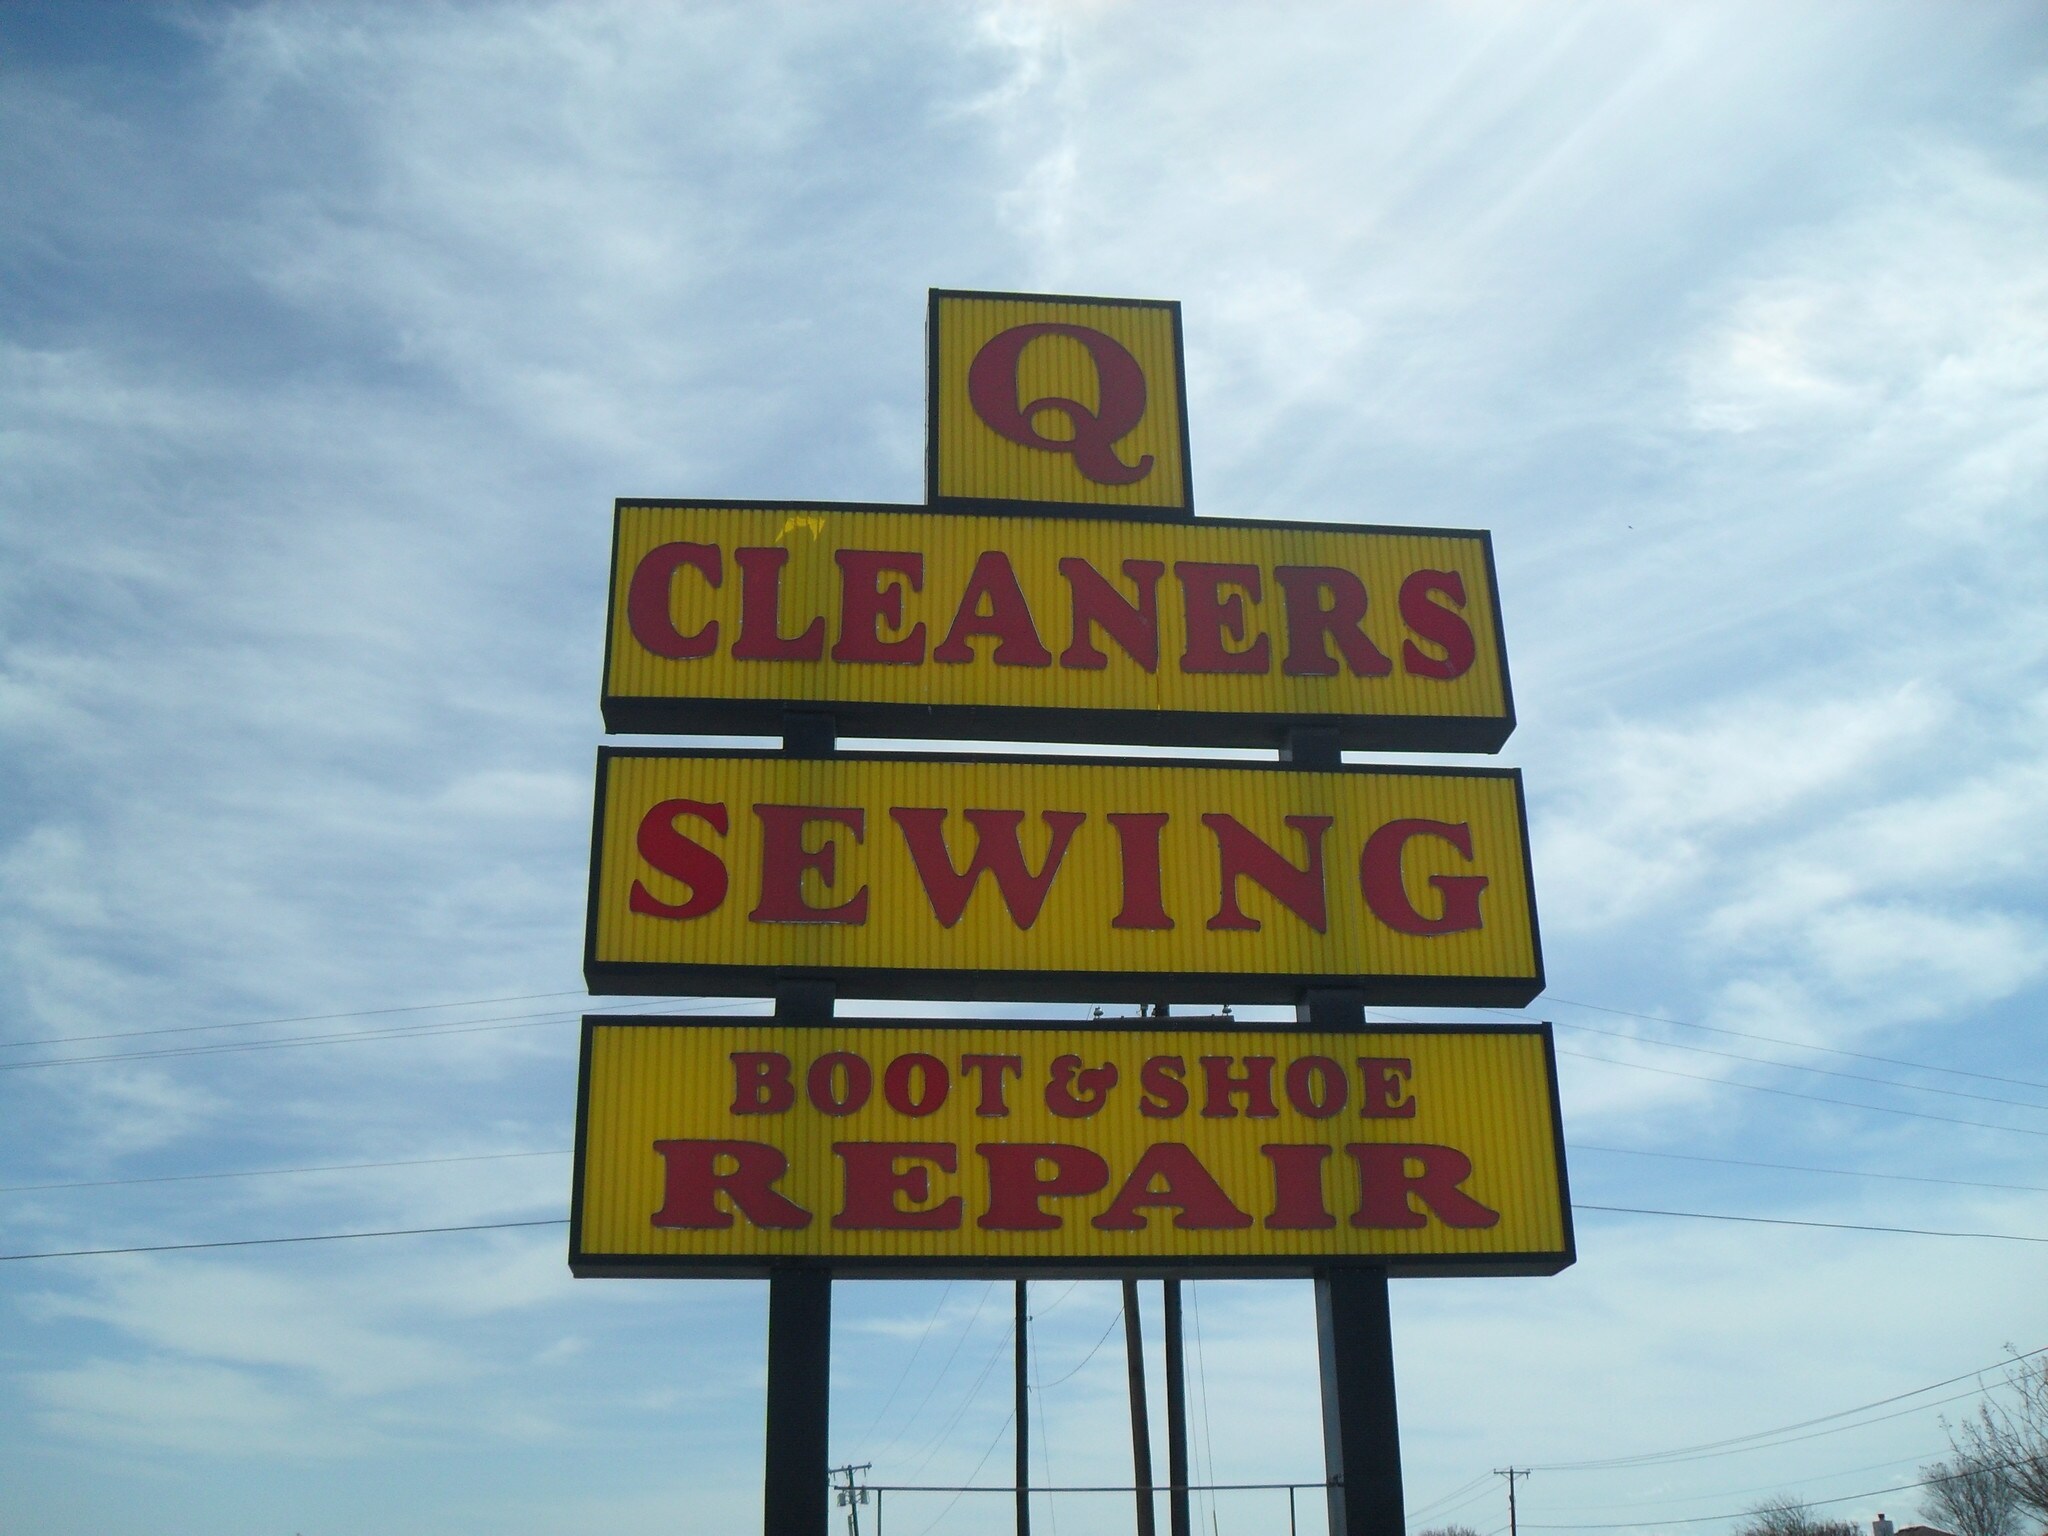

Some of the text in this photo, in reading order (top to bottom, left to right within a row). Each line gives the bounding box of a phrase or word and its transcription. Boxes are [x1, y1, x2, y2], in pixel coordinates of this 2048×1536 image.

[968, 322, 1154, 486] Q
[627, 541, 1476, 681] CLEANERS
[629, 797, 1489, 936] SEWING
[730, 1050, 1418, 1119] BOOT & SHOE
[652, 1138, 1500, 1231] REPAIR
